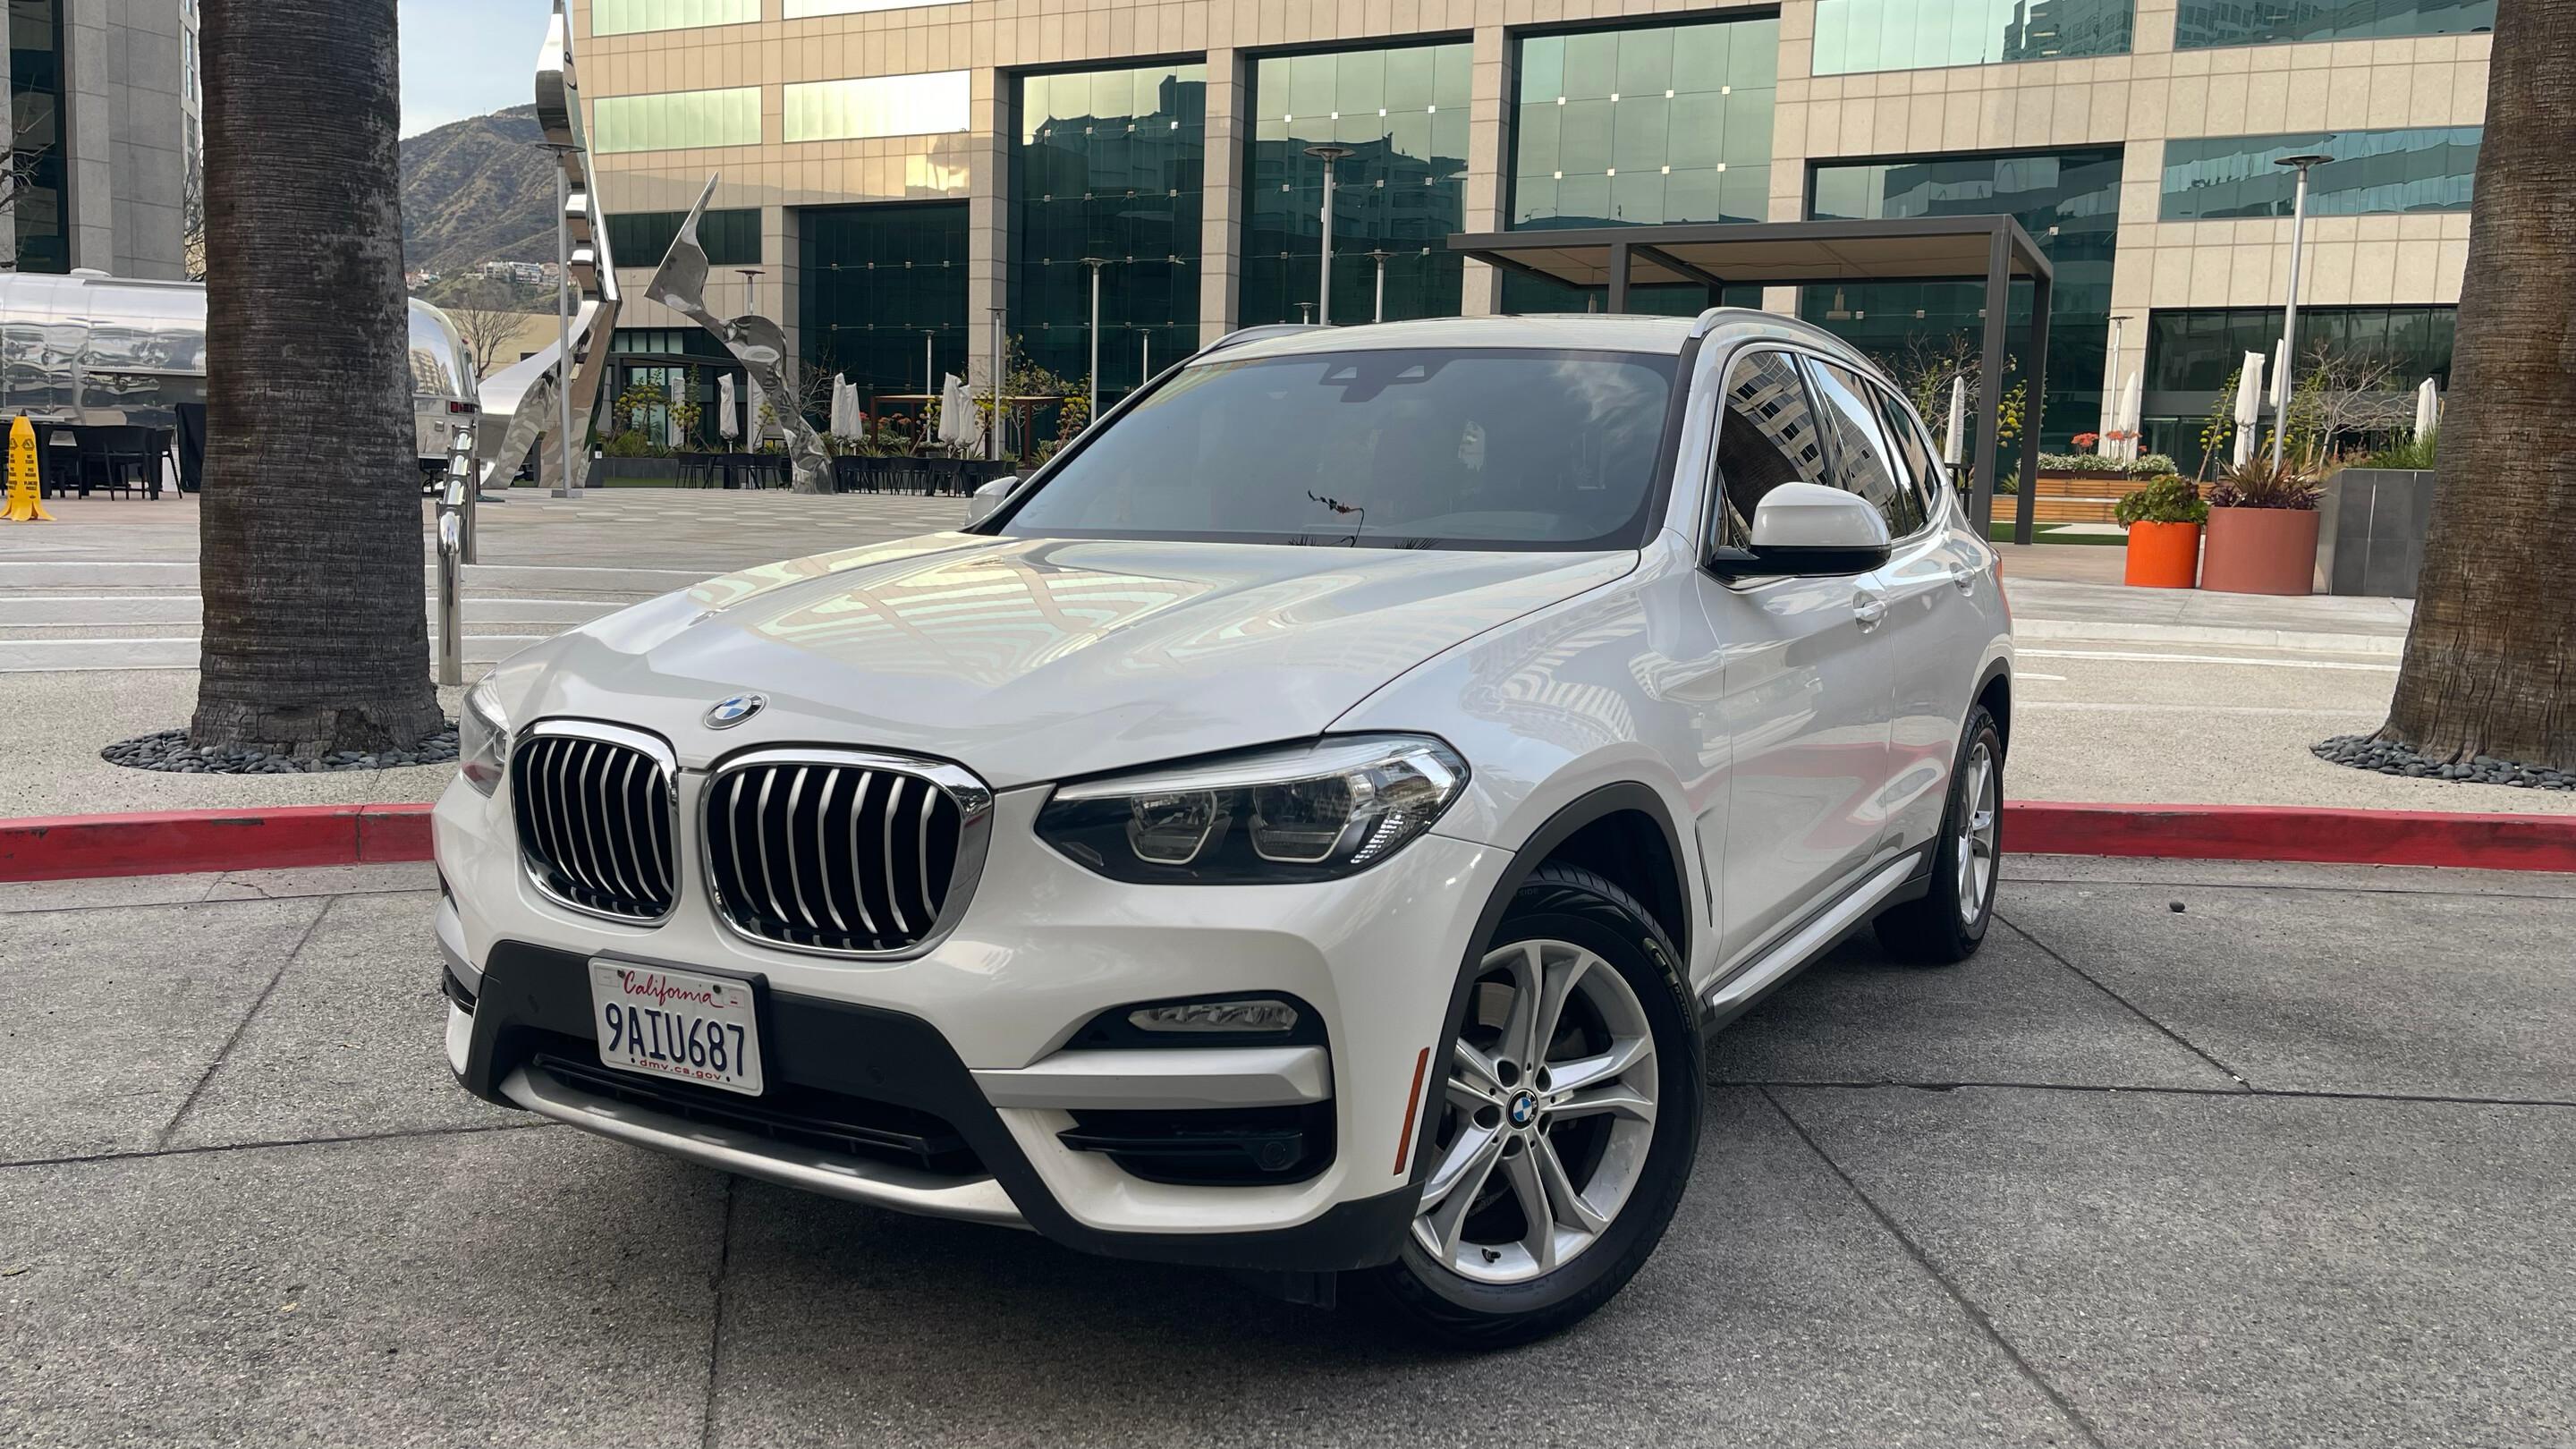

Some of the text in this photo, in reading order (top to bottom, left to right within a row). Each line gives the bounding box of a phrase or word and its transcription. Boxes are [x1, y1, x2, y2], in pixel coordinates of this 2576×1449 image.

[623, 970, 724, 1008] California
[605, 1002, 744, 1076] 9AIU687
[640, 1059, 721, 1080] dmv.ca.gov
